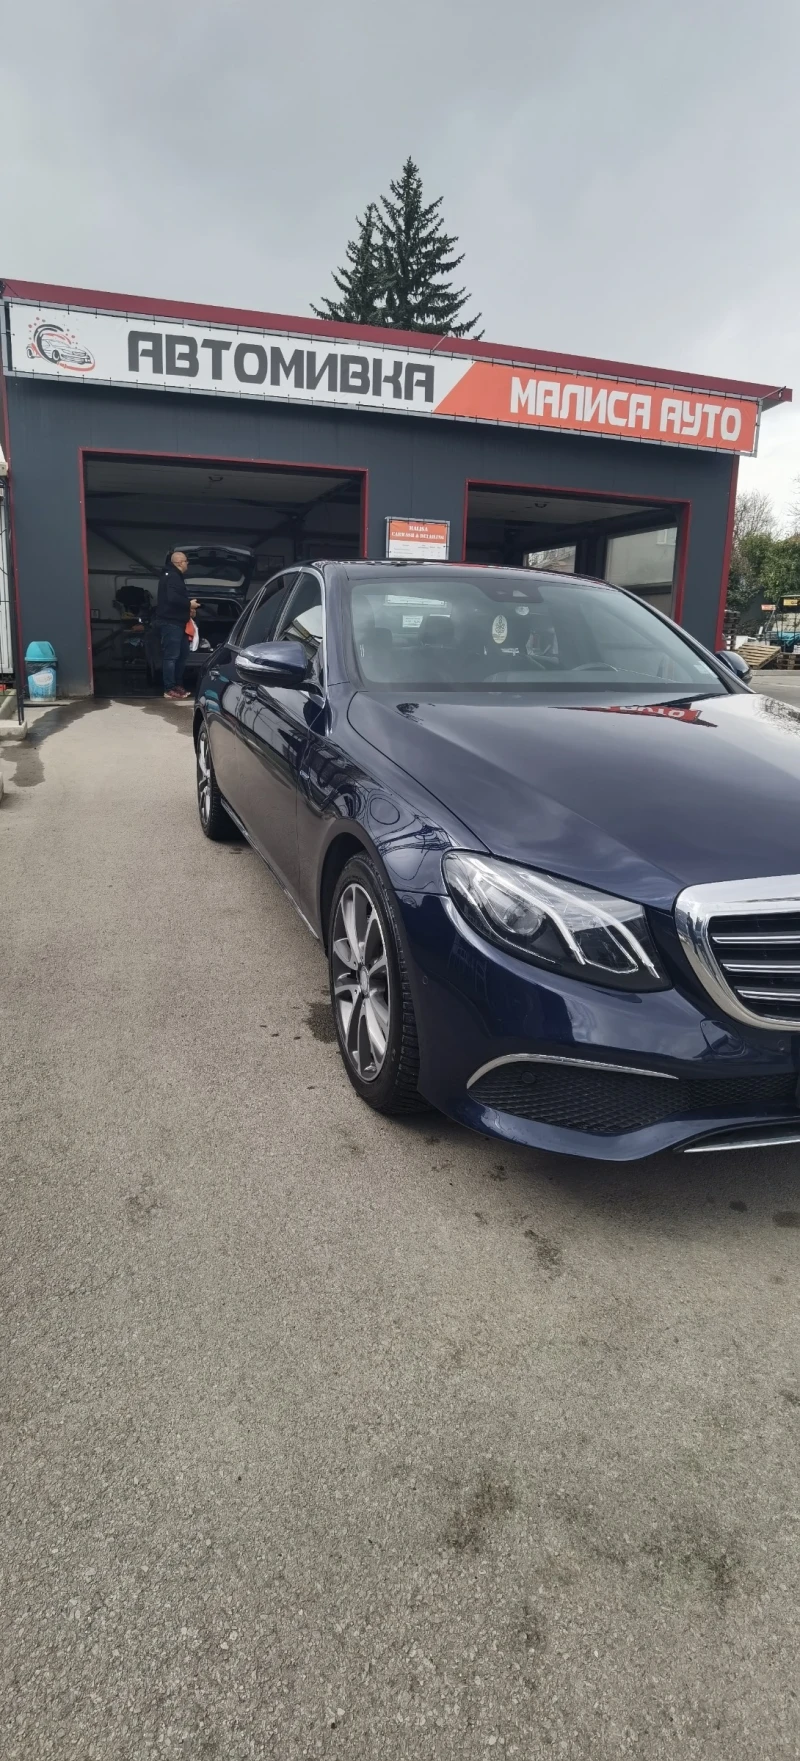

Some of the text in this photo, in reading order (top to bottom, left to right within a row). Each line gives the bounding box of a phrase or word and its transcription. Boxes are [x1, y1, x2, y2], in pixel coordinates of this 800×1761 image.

[128, 331, 434, 403] АВТОМИВКА
[510, 376, 741, 442] МАЛИСА АУТО
